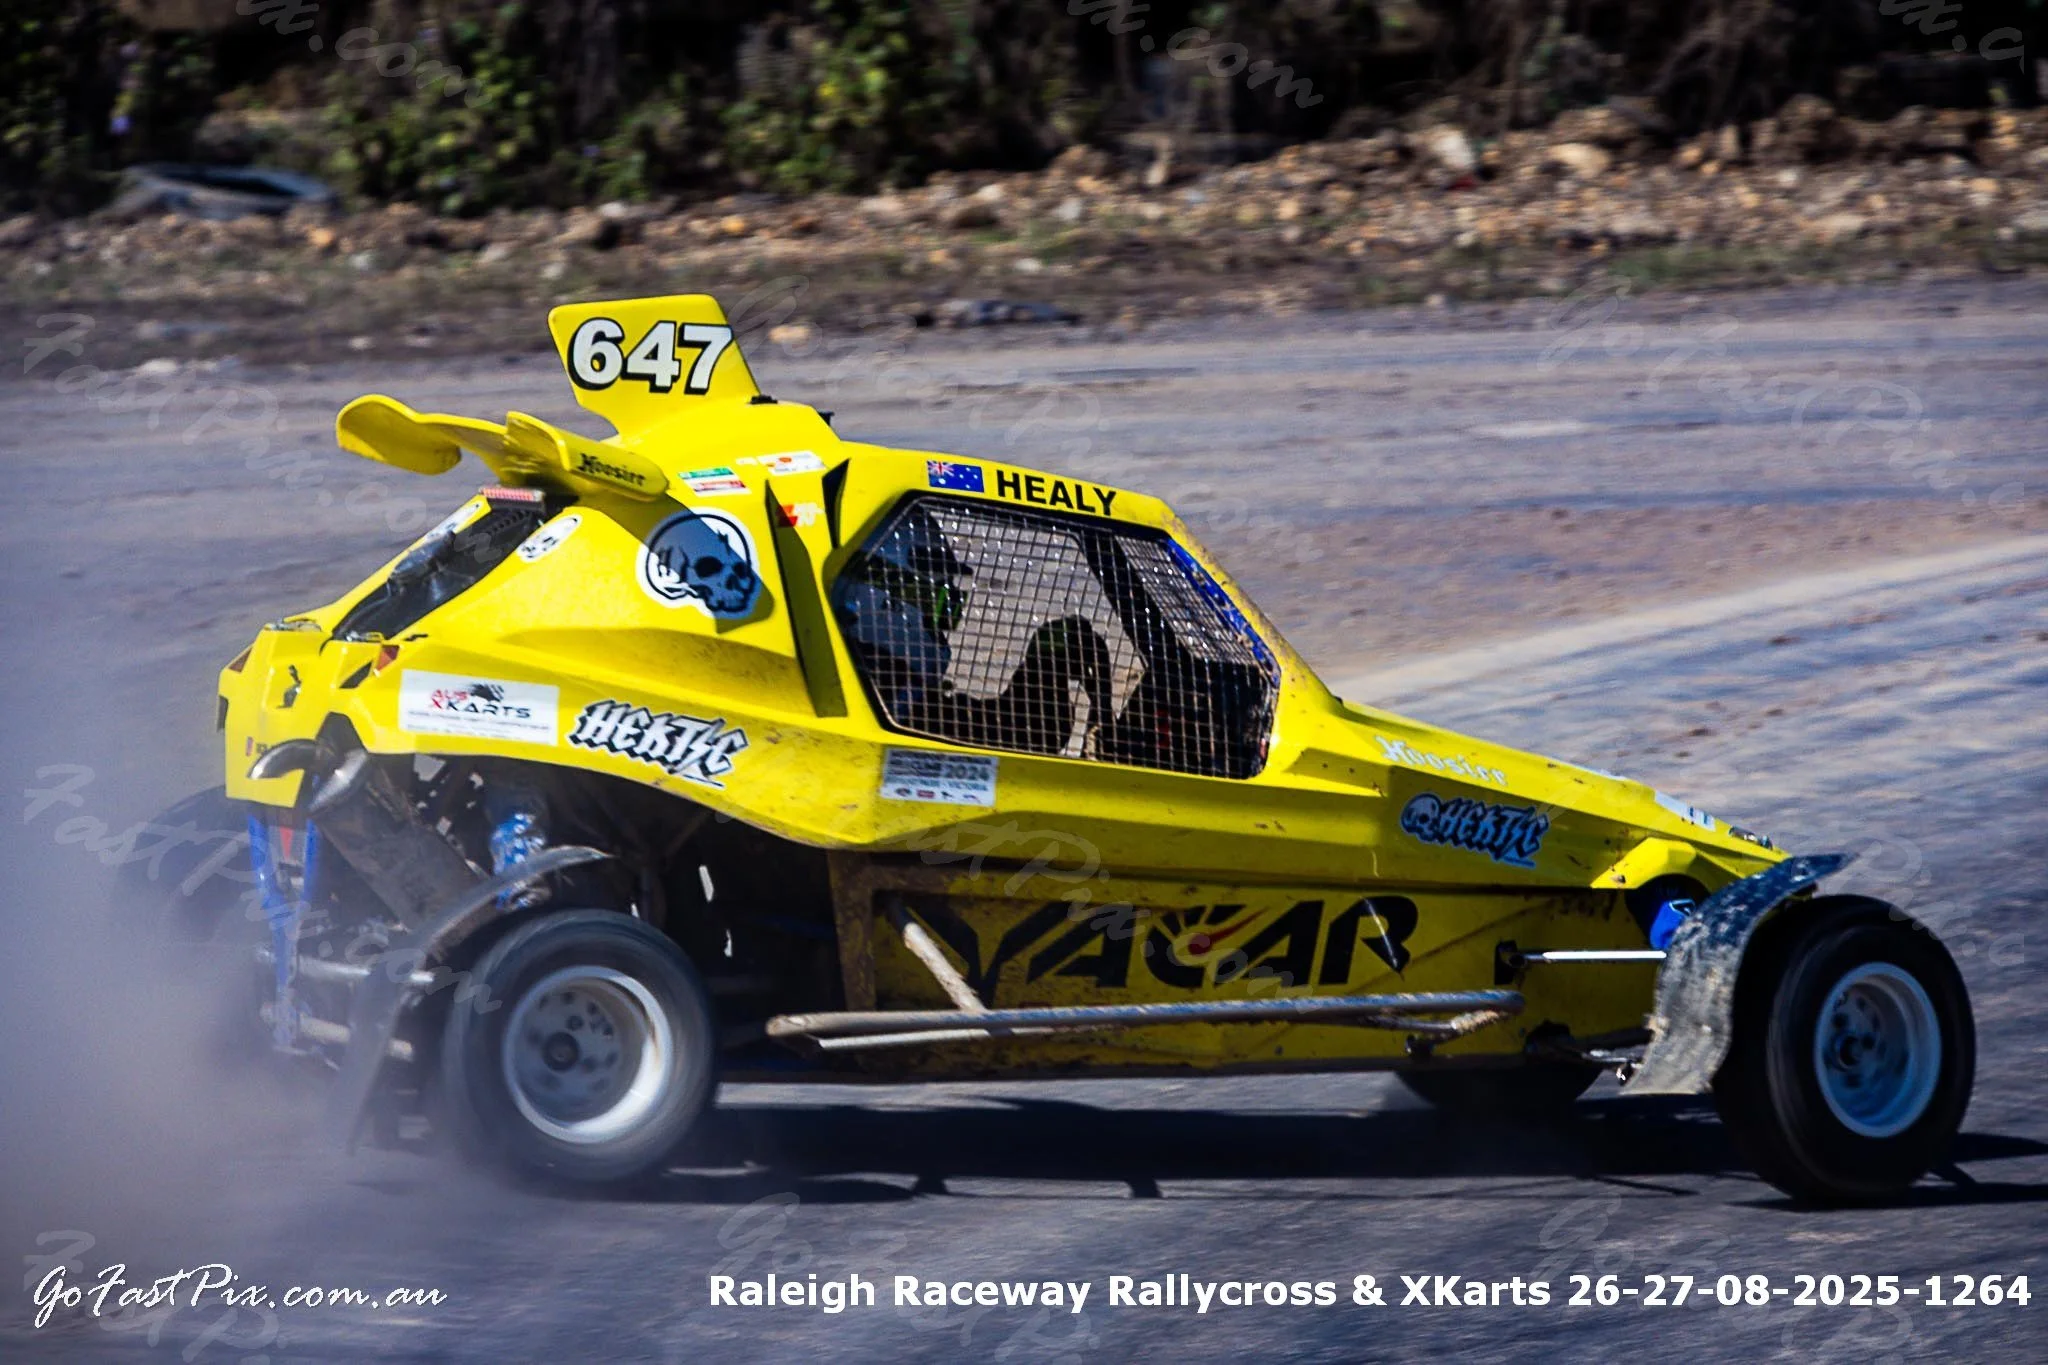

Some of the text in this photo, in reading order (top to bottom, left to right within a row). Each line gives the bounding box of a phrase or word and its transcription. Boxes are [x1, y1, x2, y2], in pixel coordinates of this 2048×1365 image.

[568, 317, 734, 394] 647
[578, 453, 646, 487] Hoosier
[996, 470, 1117, 516] HEALY
[1375, 735, 1508, 786] Hoosier
